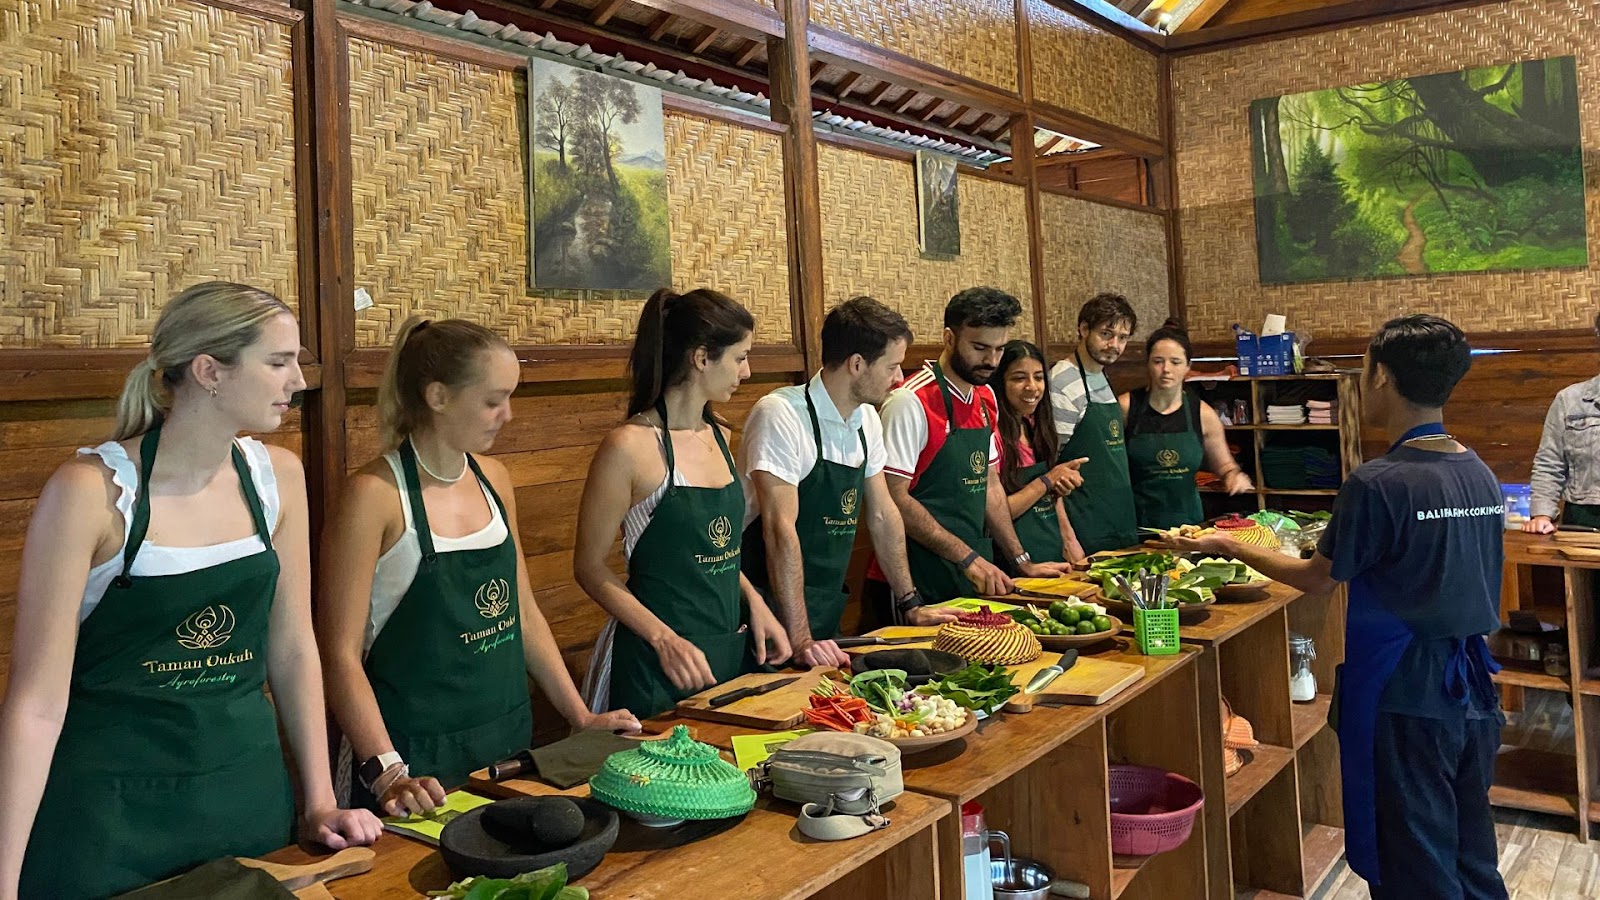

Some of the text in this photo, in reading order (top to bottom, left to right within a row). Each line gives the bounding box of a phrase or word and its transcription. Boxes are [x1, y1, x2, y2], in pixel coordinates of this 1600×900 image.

[695, 554, 724, 563] Taman
[460, 626, 497, 644] Taman
[142, 659, 202, 673] Taman
[159, 670, 237, 690] Agroforestry
